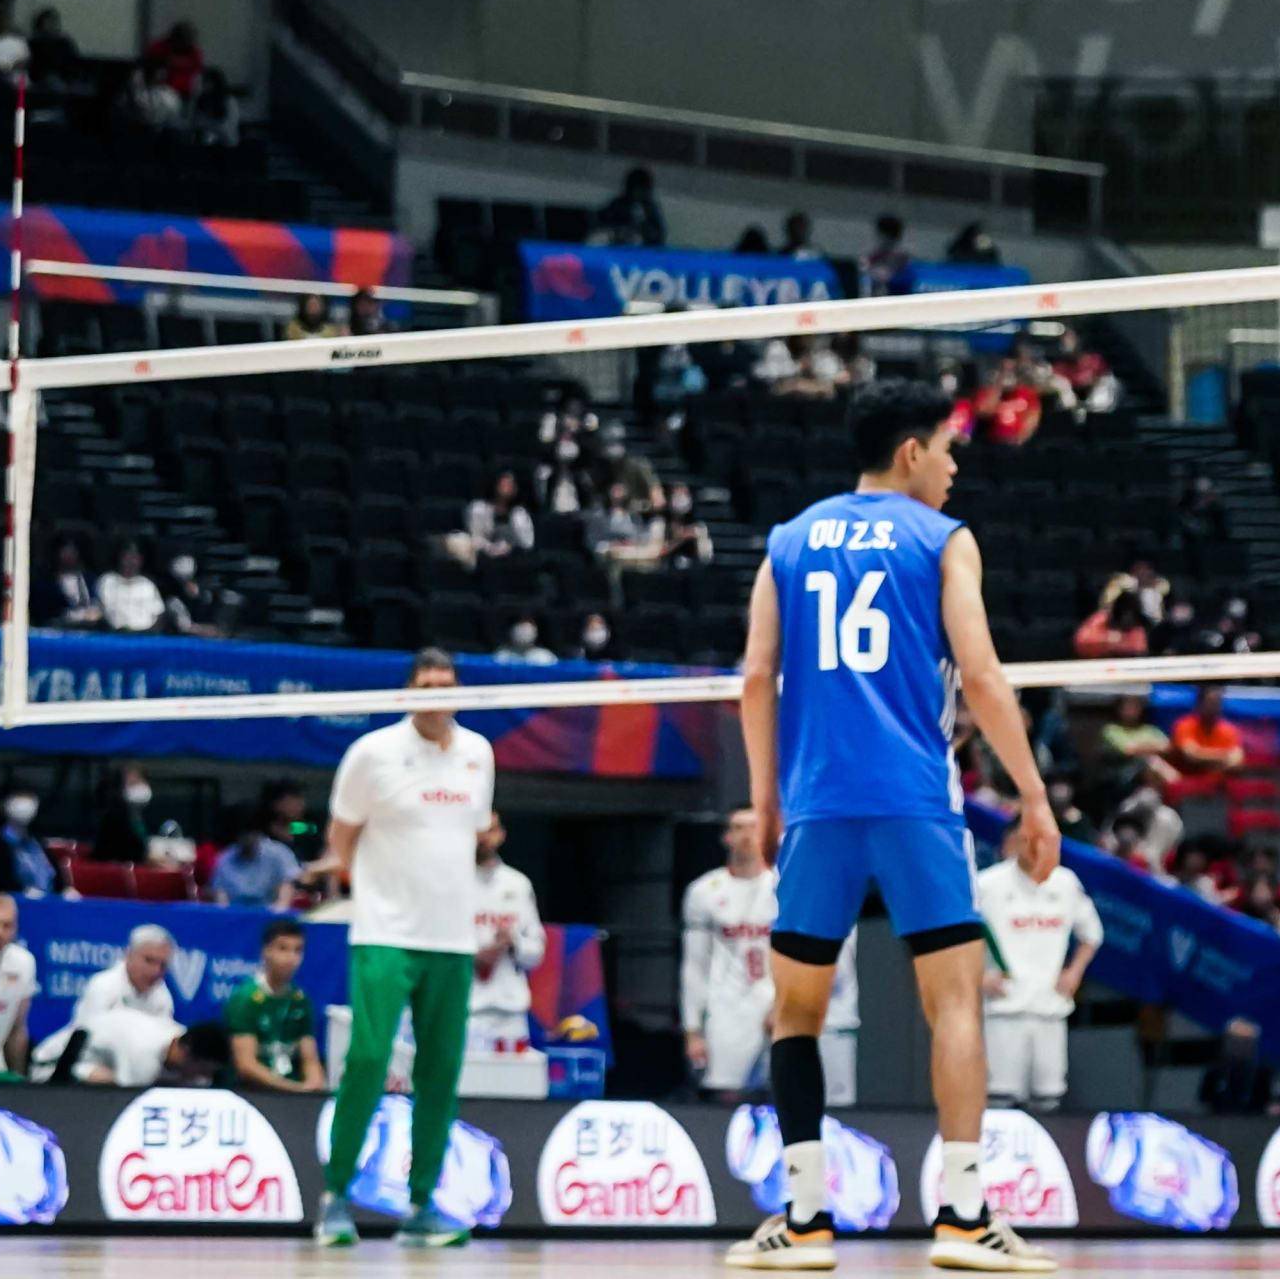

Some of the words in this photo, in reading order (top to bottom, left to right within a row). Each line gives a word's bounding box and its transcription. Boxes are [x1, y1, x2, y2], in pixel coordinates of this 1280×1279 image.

[846, 520, 898, 551] Z.S.
[805, 570, 891, 673] 16
[142, 1106, 248, 1149] 百岁山
